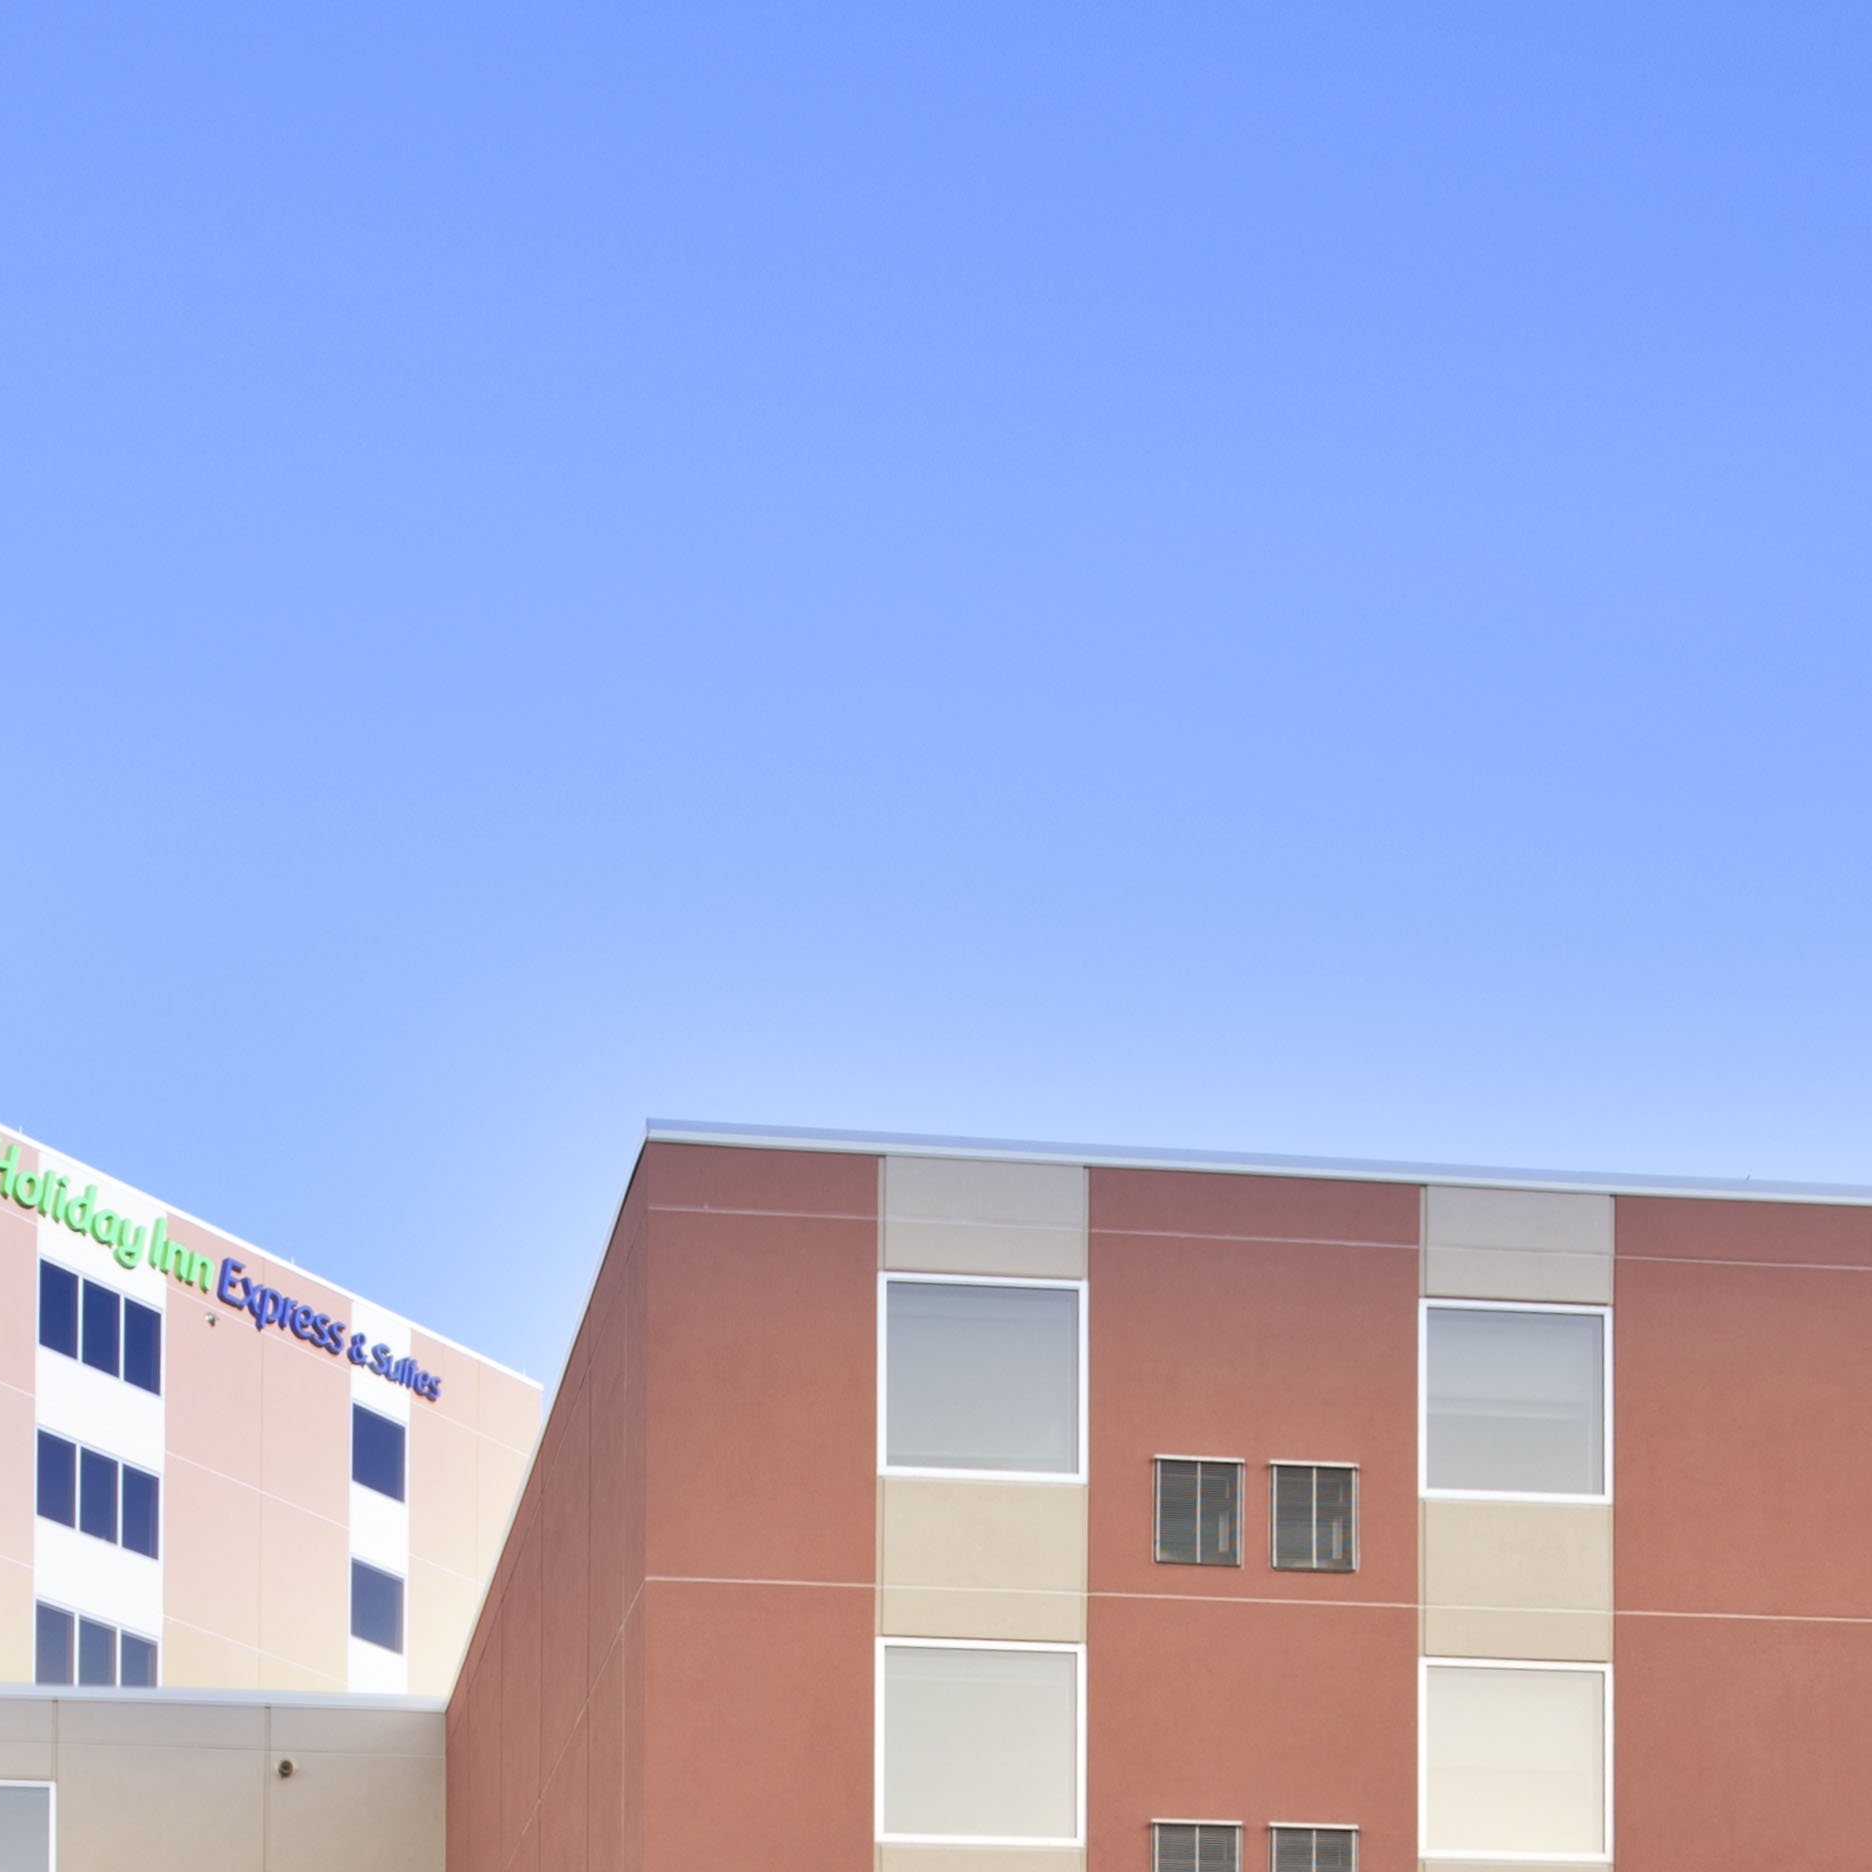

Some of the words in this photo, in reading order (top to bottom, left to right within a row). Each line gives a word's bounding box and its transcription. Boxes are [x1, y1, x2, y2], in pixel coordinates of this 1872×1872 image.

[149, 1217, 215, 1294] Inn
[217, 1257, 346, 1356] Express
[347, 1332, 368, 1367] &
[368, 1344, 442, 1402] Suites
